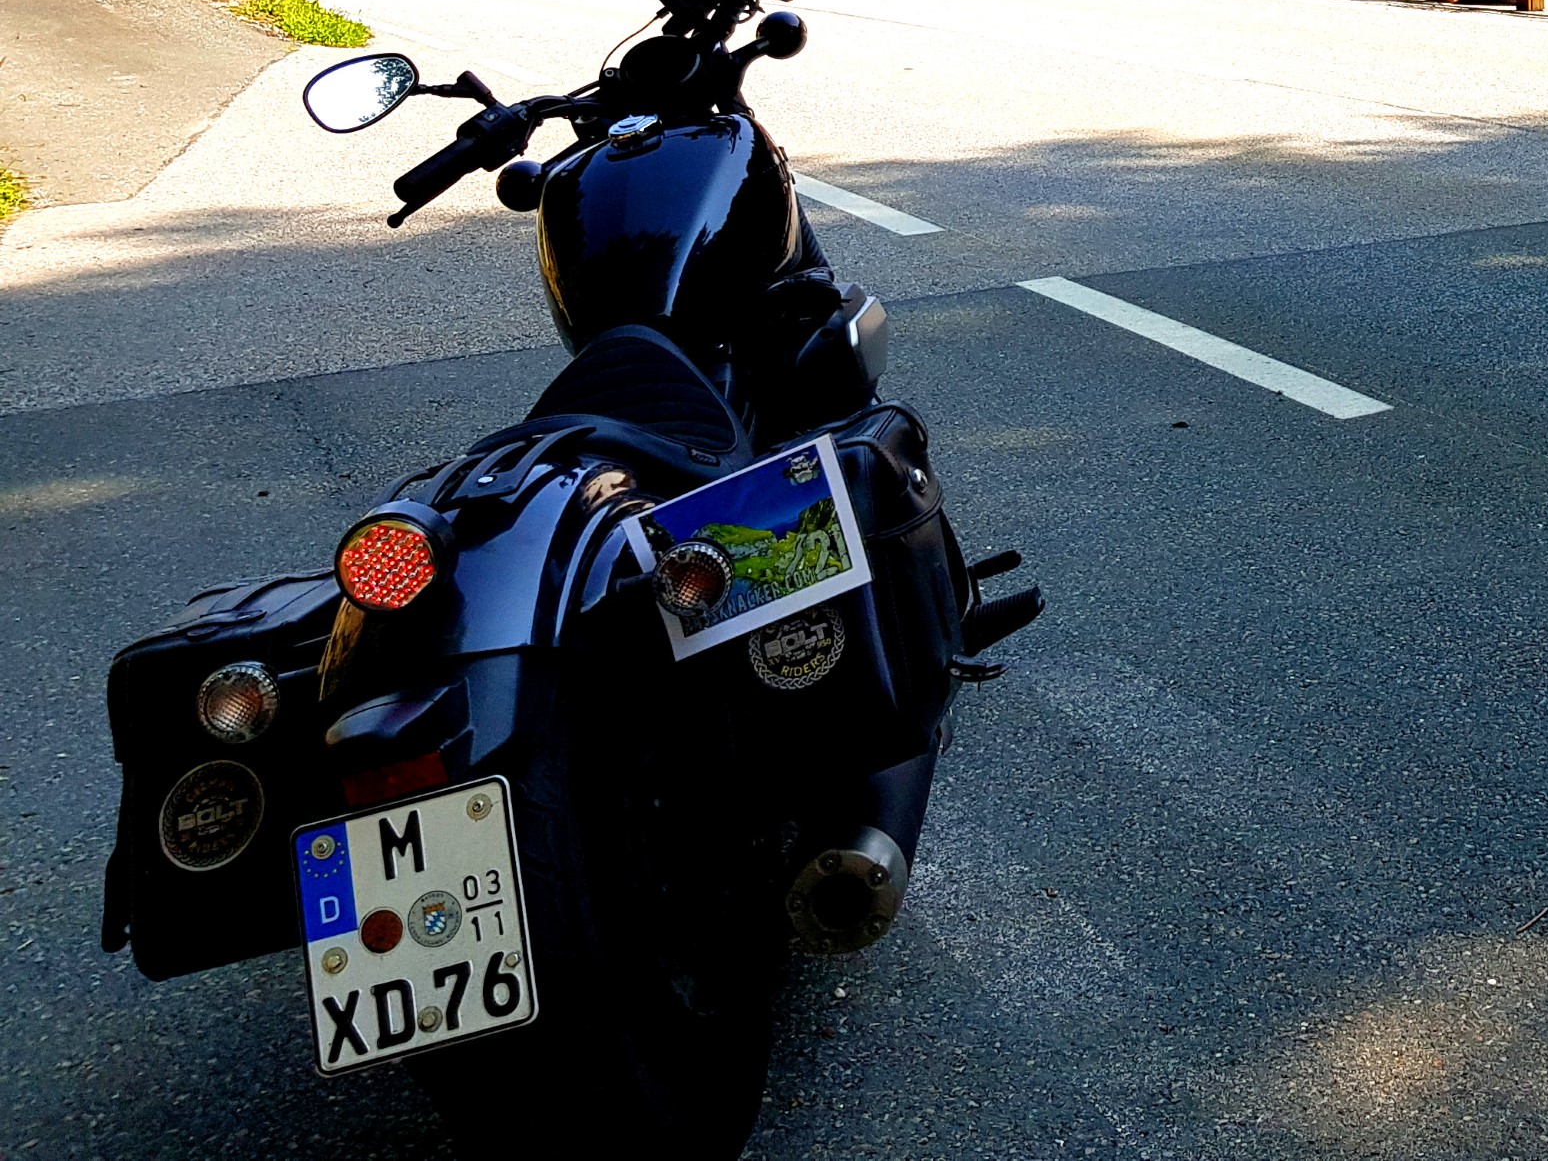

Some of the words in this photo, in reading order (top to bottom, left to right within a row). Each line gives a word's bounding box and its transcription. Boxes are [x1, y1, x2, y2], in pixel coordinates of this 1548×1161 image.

[764, 622, 828, 658] BOLT
[781, 652, 826, 677] RIDERS
[177, 798, 249, 831] BOLT
[378, 810, 427, 881] M
[463, 869, 501, 901] 03
[319, 896, 340, 925] D
[470, 910, 505, 943] 11
